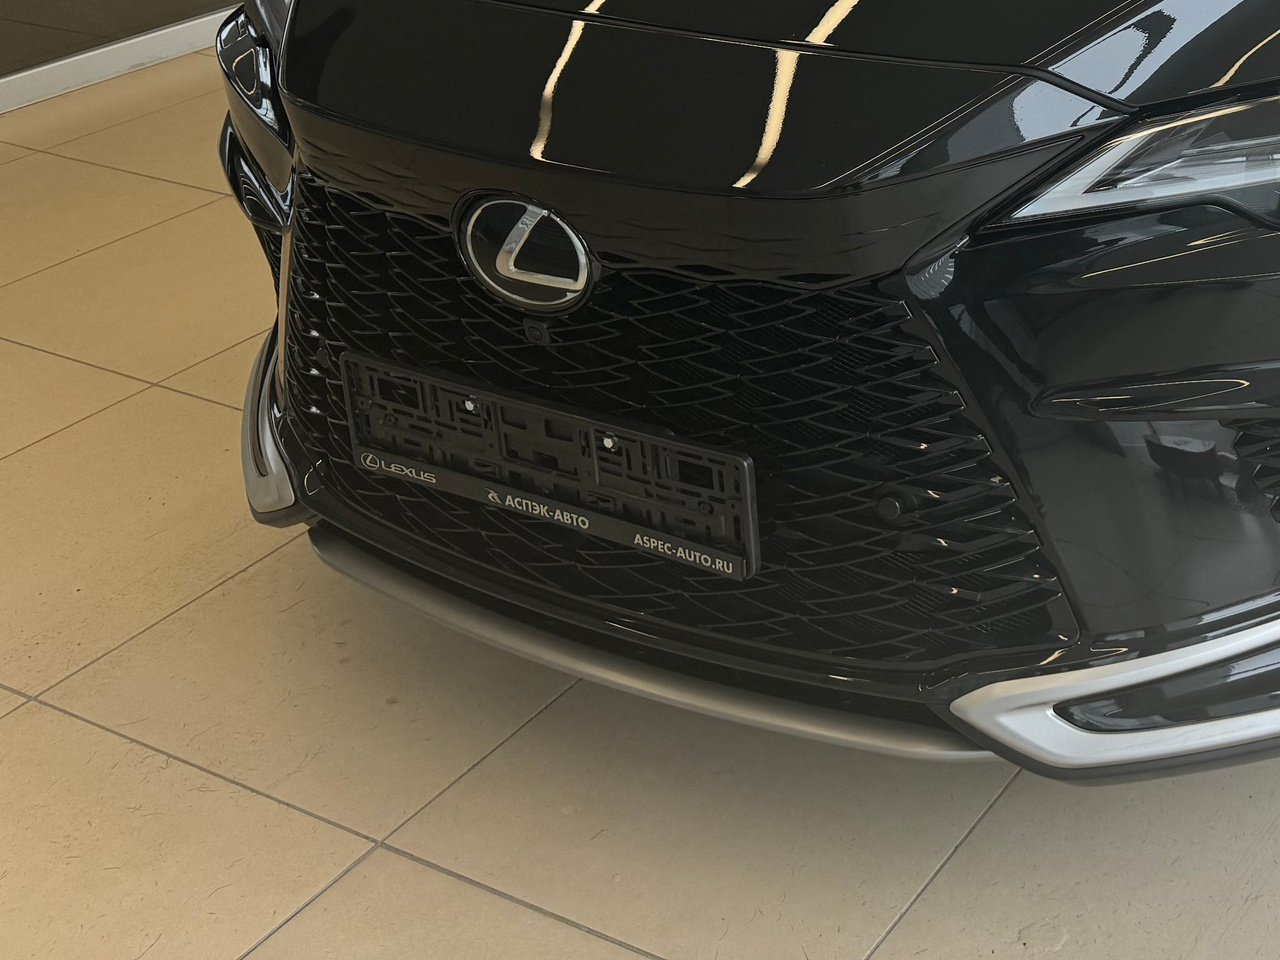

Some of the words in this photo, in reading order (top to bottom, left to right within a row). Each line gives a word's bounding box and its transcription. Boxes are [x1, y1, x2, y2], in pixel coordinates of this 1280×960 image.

[381, 460, 437, 484] LEXUS
[505, 494, 590, 530] АСПЭК-АВТО
[633, 533, 734, 574] ASPEC-AUTO.RU
